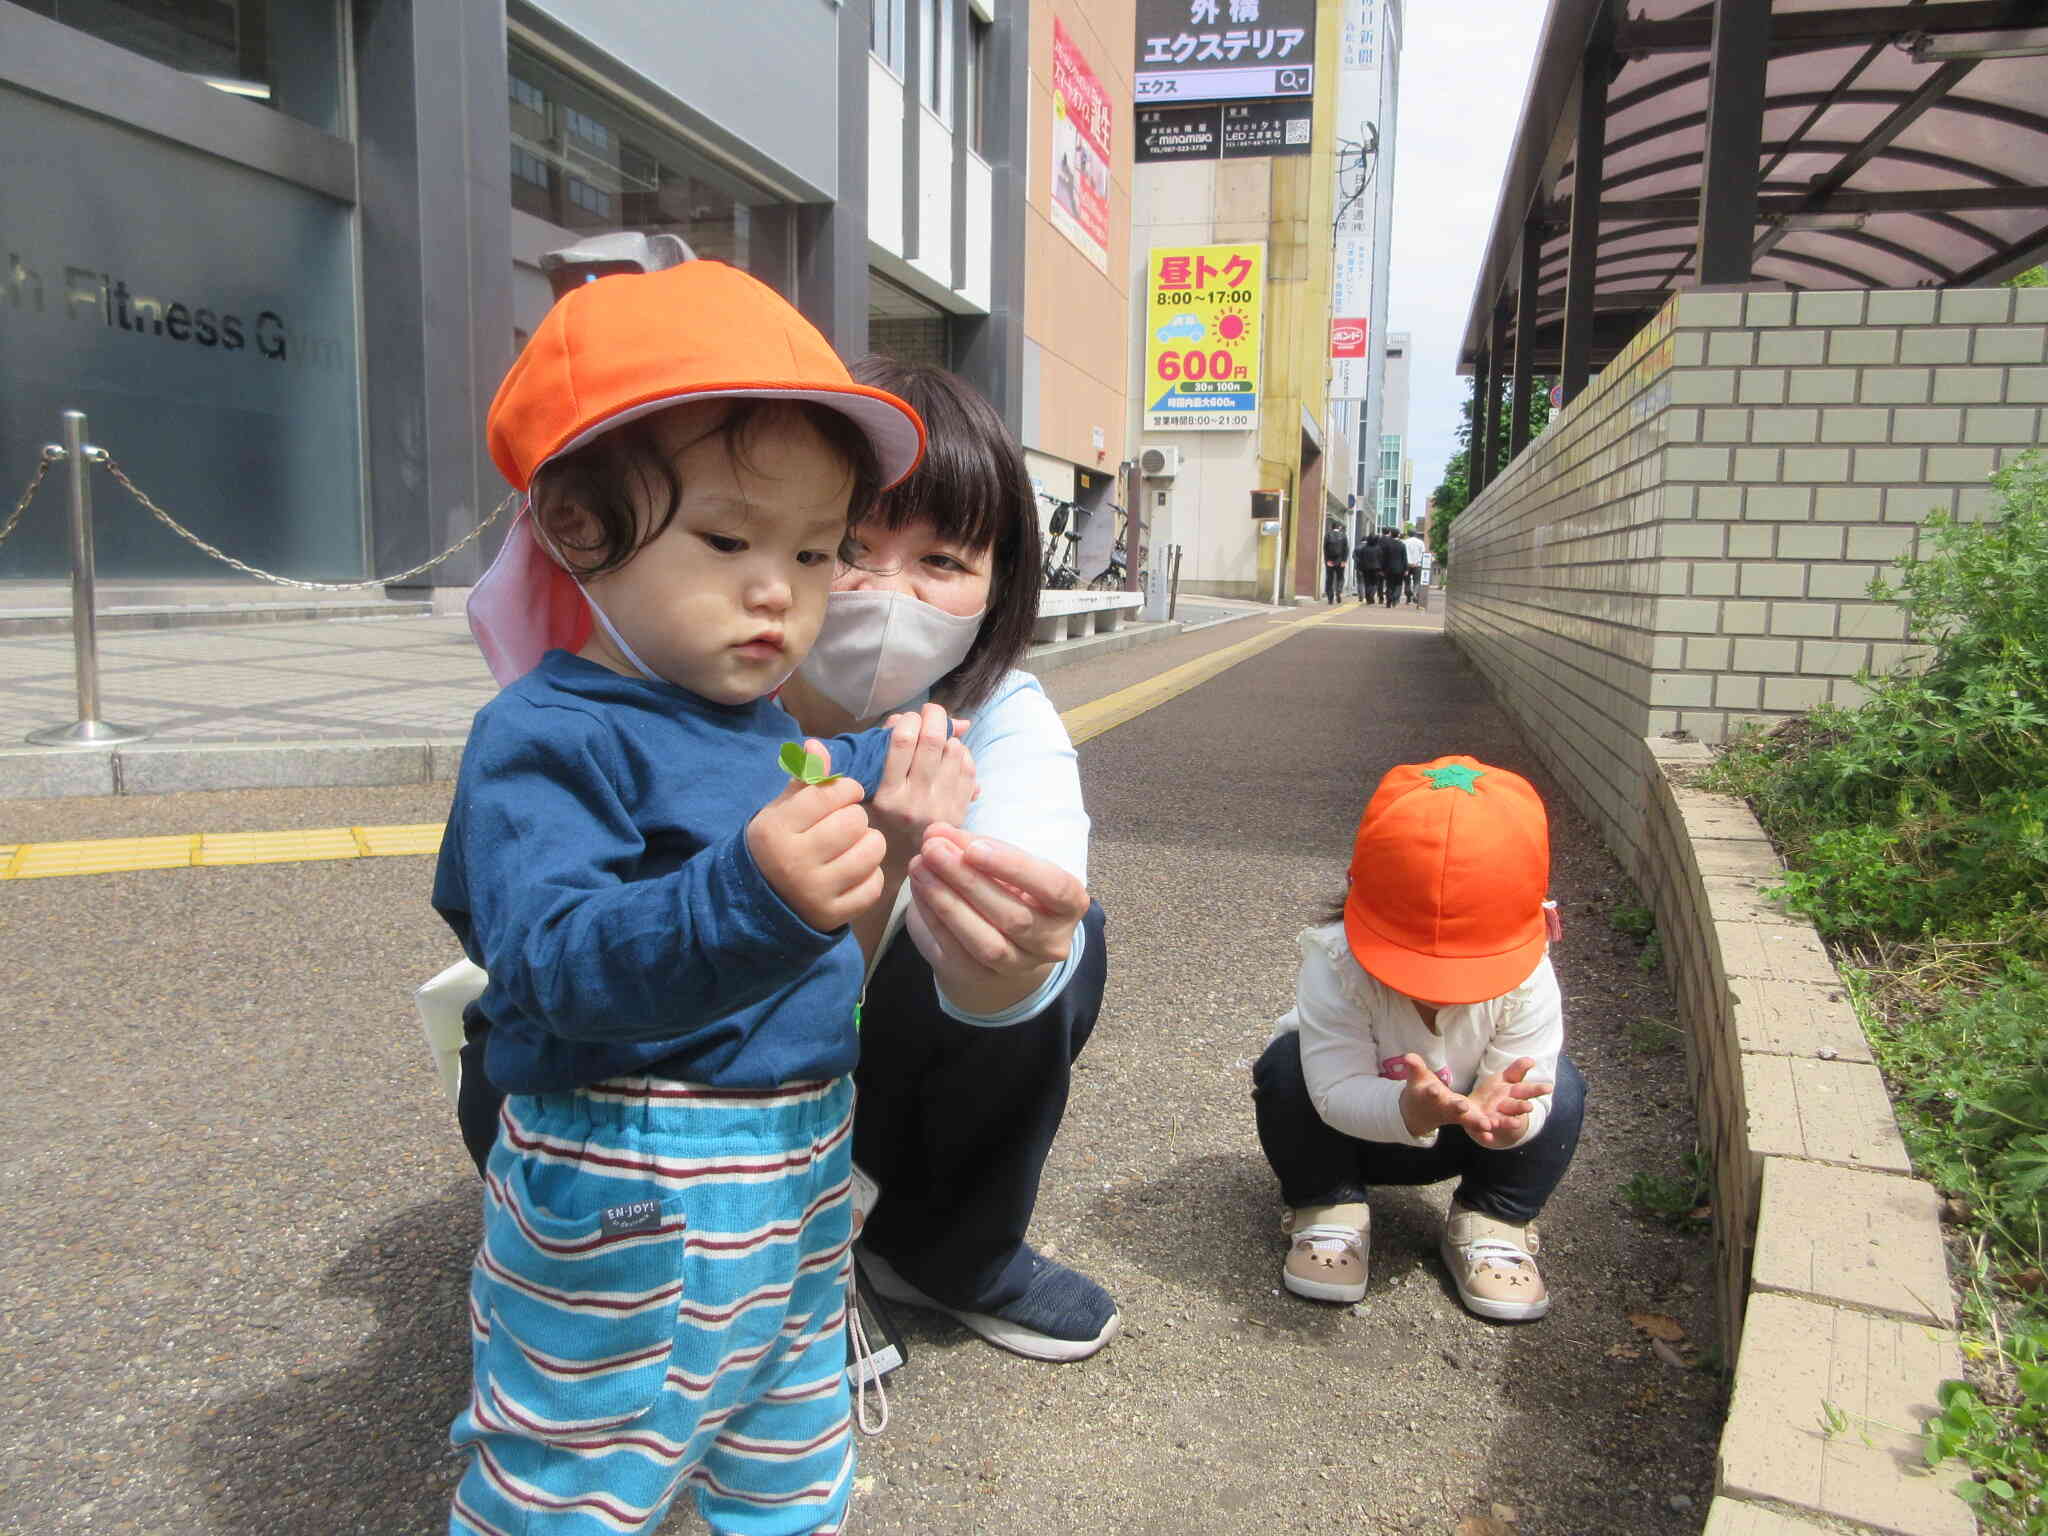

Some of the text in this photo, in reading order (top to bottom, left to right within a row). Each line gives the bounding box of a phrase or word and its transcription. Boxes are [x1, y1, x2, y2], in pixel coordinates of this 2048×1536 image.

[1190, 0, 1259, 24] 外構
[1144, 29, 1304, 64] エクステリア
[1138, 79, 1178, 94] エクス
[1158, 254, 1253, 290] 昼トク
[1157, 350, 1248, 381] 600円
